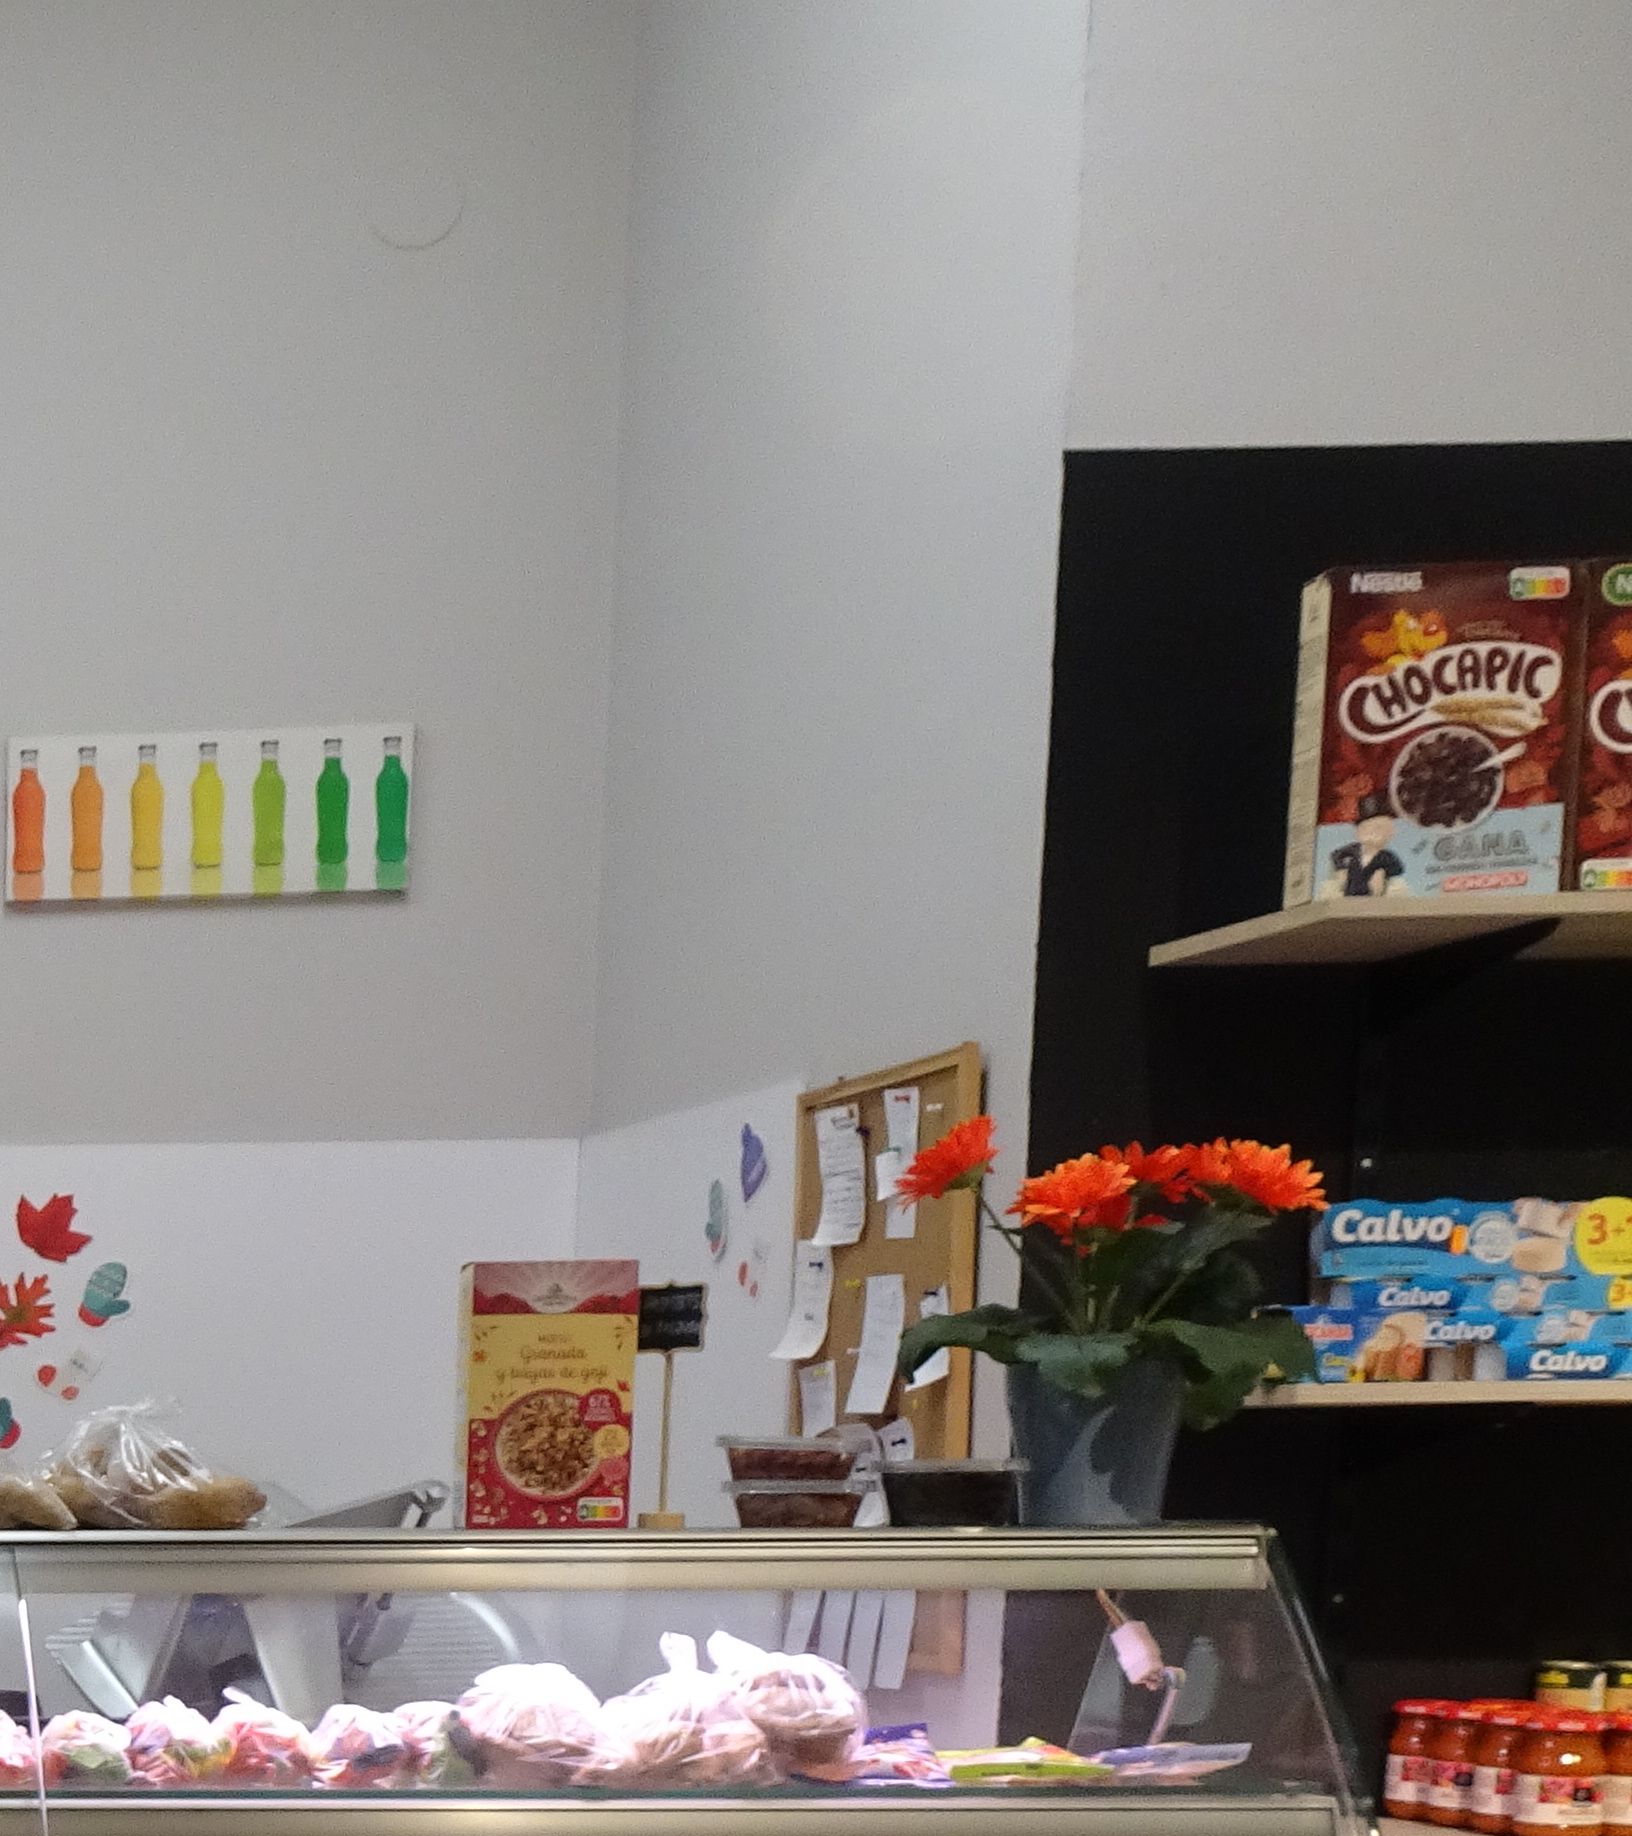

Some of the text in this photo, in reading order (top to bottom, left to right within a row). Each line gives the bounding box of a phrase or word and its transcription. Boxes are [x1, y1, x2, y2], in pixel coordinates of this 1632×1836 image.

[1347, 647, 1553, 735] CHOCAPIC
[1331, 1208, 1454, 1243] Calvo
[1378, 1286, 1452, 1307] Calvo
[1424, 1319, 1497, 1341] Calvo
[1529, 1349, 1609, 1372] Calvo
